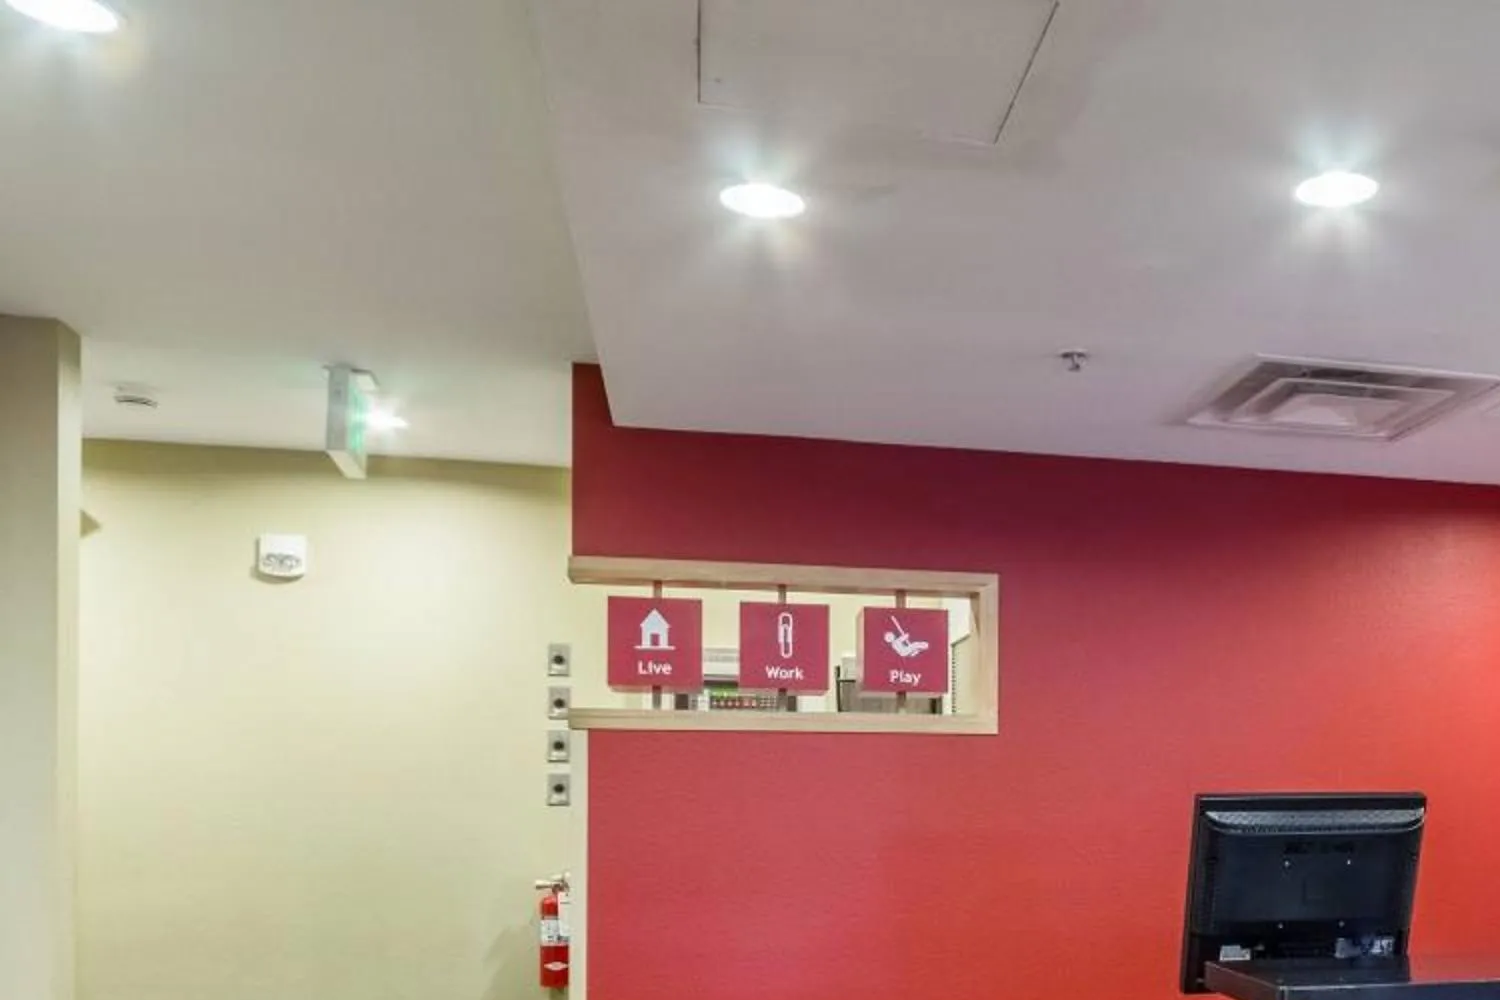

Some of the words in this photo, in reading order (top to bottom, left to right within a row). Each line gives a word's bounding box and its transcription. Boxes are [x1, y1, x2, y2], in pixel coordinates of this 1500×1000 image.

[637, 660, 673, 676] Live
[765, 665, 804, 681] Work
[889, 670, 922, 686] Play
